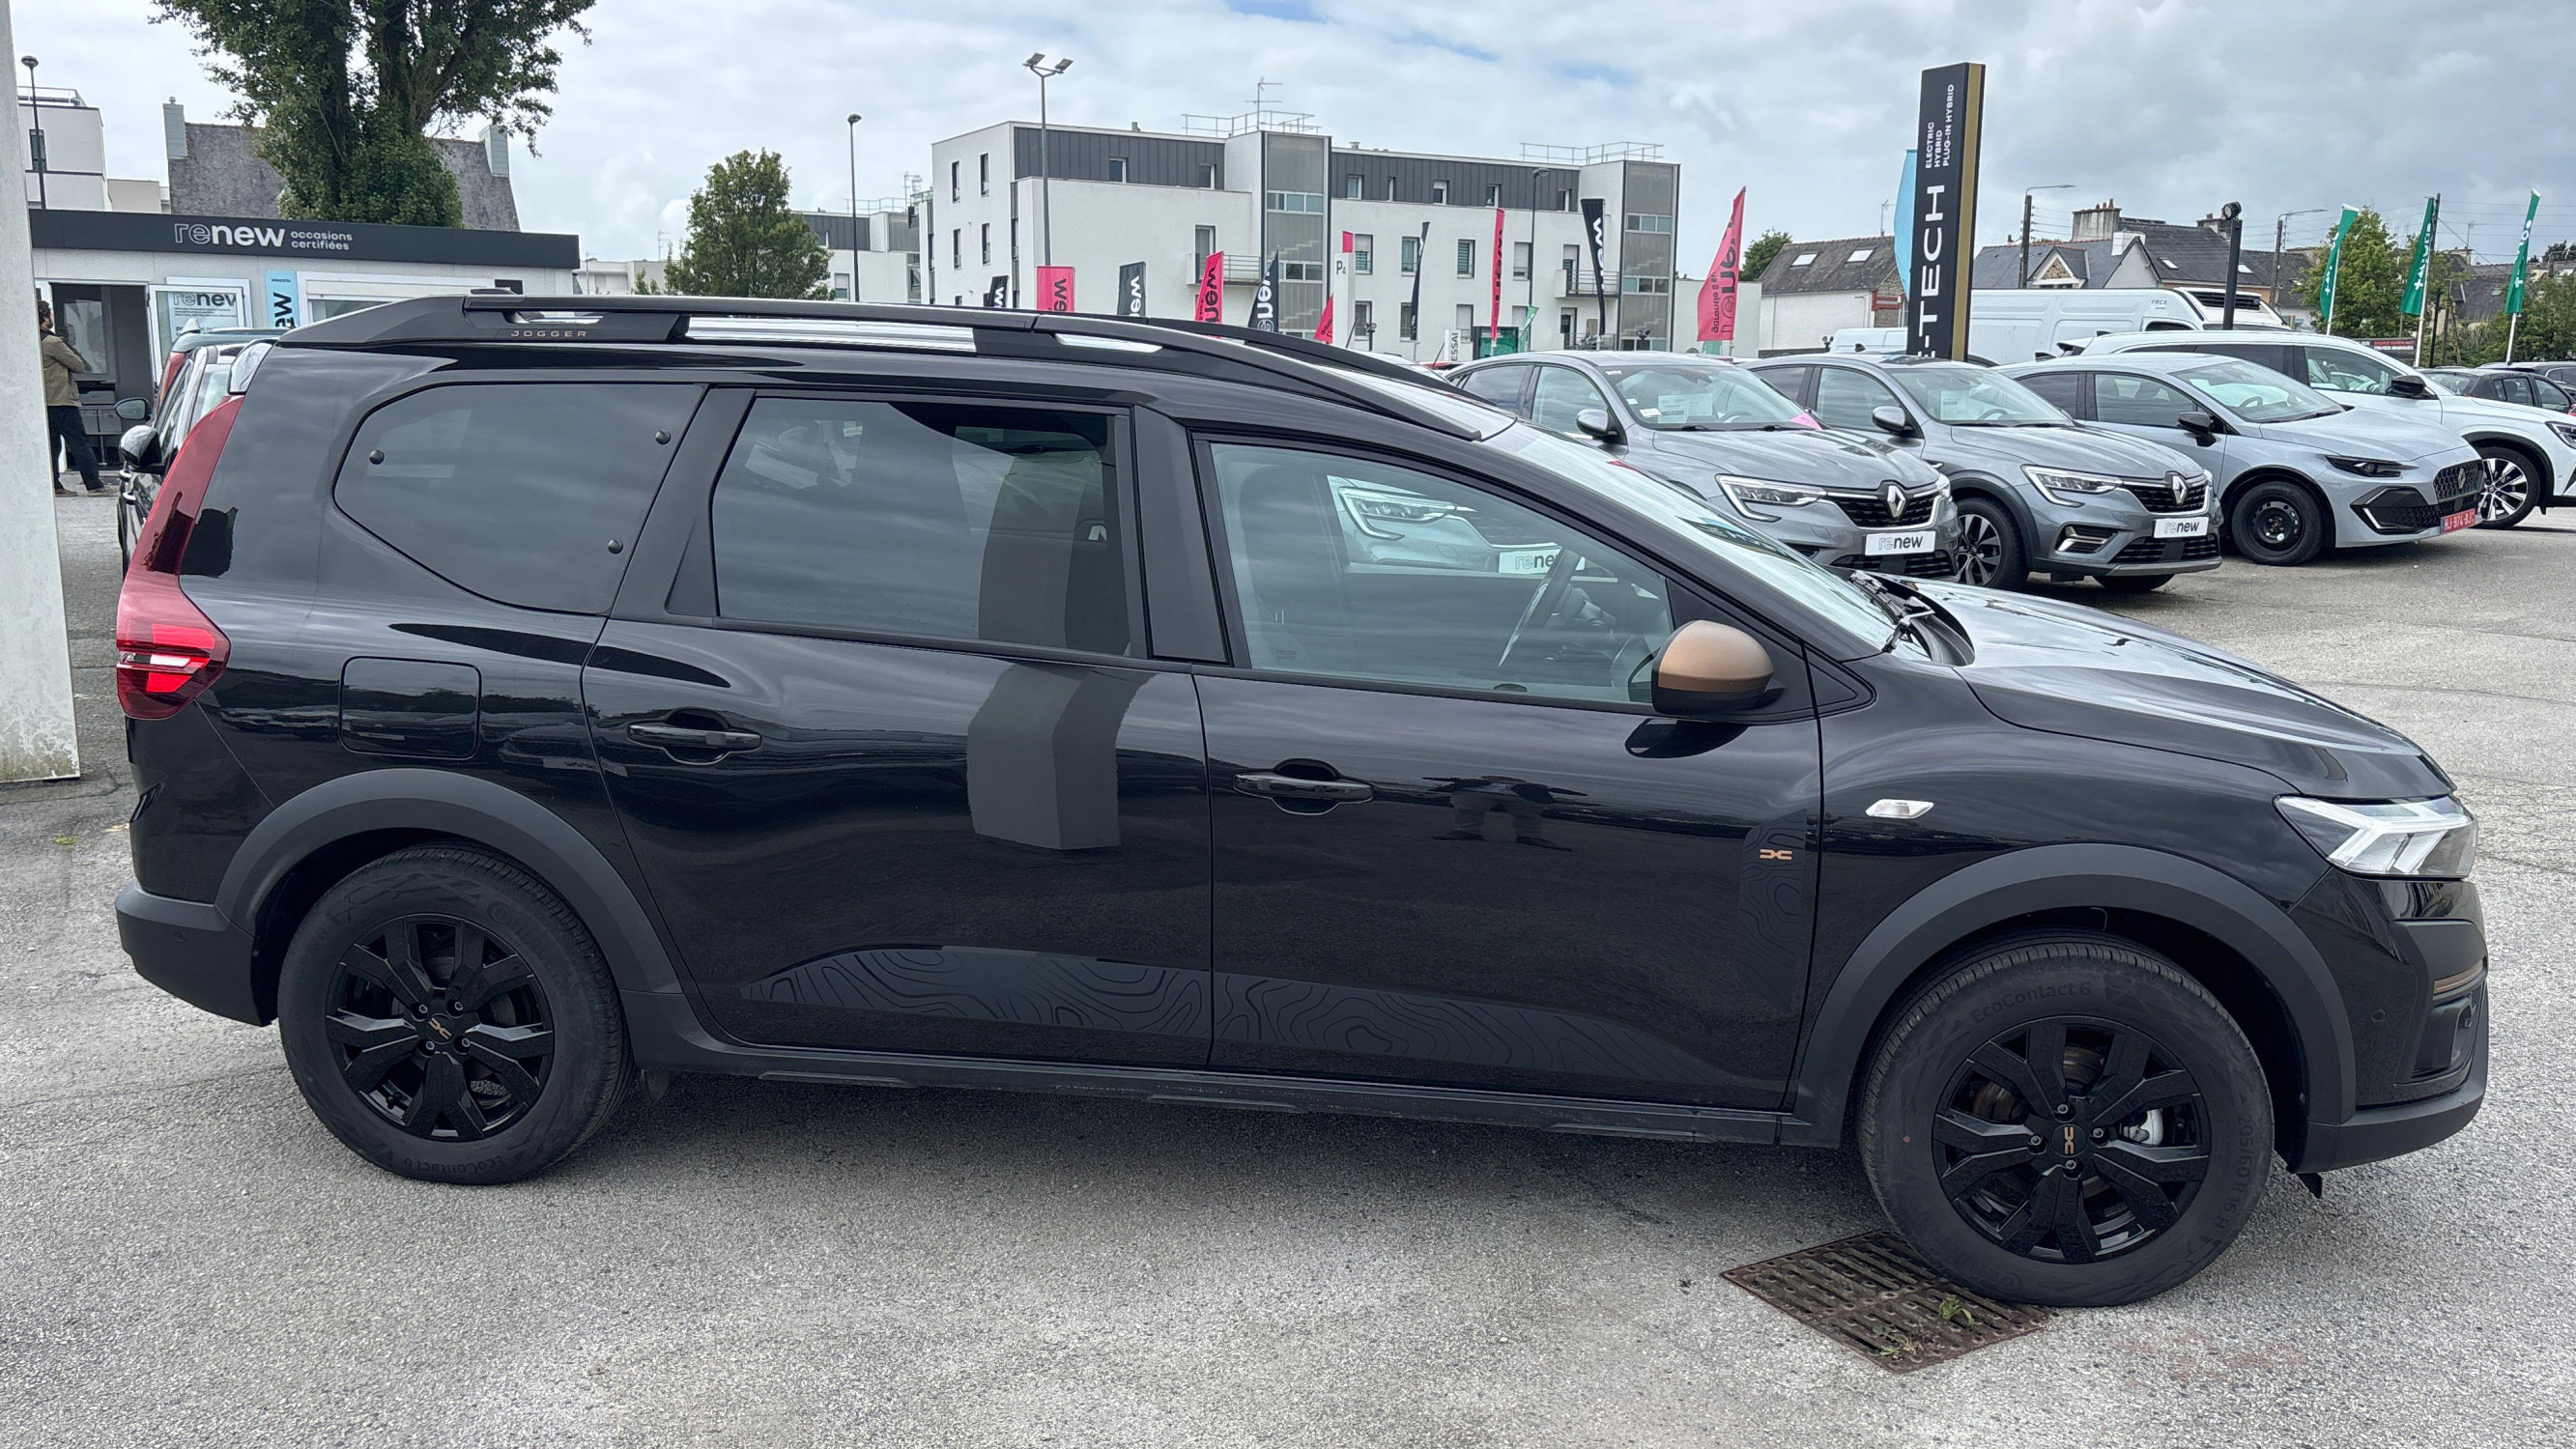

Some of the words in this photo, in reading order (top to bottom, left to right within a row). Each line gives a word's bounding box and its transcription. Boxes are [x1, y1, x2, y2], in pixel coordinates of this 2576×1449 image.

[1945, 83, 1955, 123] HYBRID
[1925, 121, 1934, 169] ELECTRIC
[1933, 129, 1943, 168] HYBRID
[1942, 124, 1952, 166] PLUG-IN
[174, 223, 286, 247] renew
[291, 230, 353, 242] occasions
[291, 240, 351, 251] certifiées
[1878, 536, 1924, 550] renew
[2164, 522, 2200, 534] renew
[1970, 982, 2075, 1024] EcoContact
[2079, 981, 2091, 996] 6
